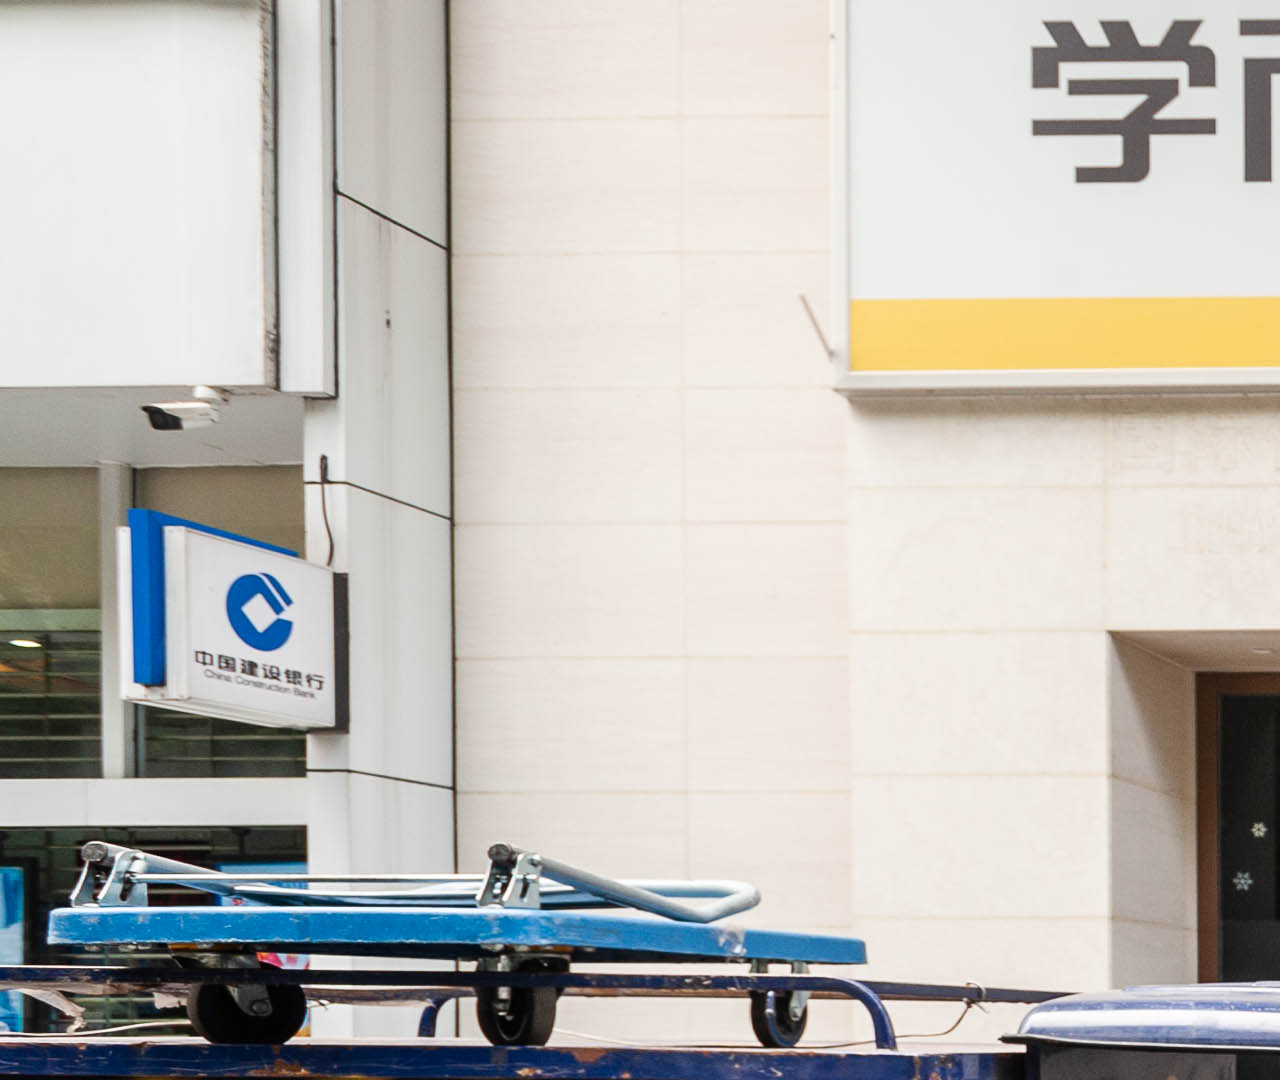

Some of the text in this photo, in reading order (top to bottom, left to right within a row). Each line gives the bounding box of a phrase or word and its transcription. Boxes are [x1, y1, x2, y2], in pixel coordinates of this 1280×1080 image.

[194, 650, 325, 691] 中国建设银行
[203, 668, 316, 699] China Construction Bank
